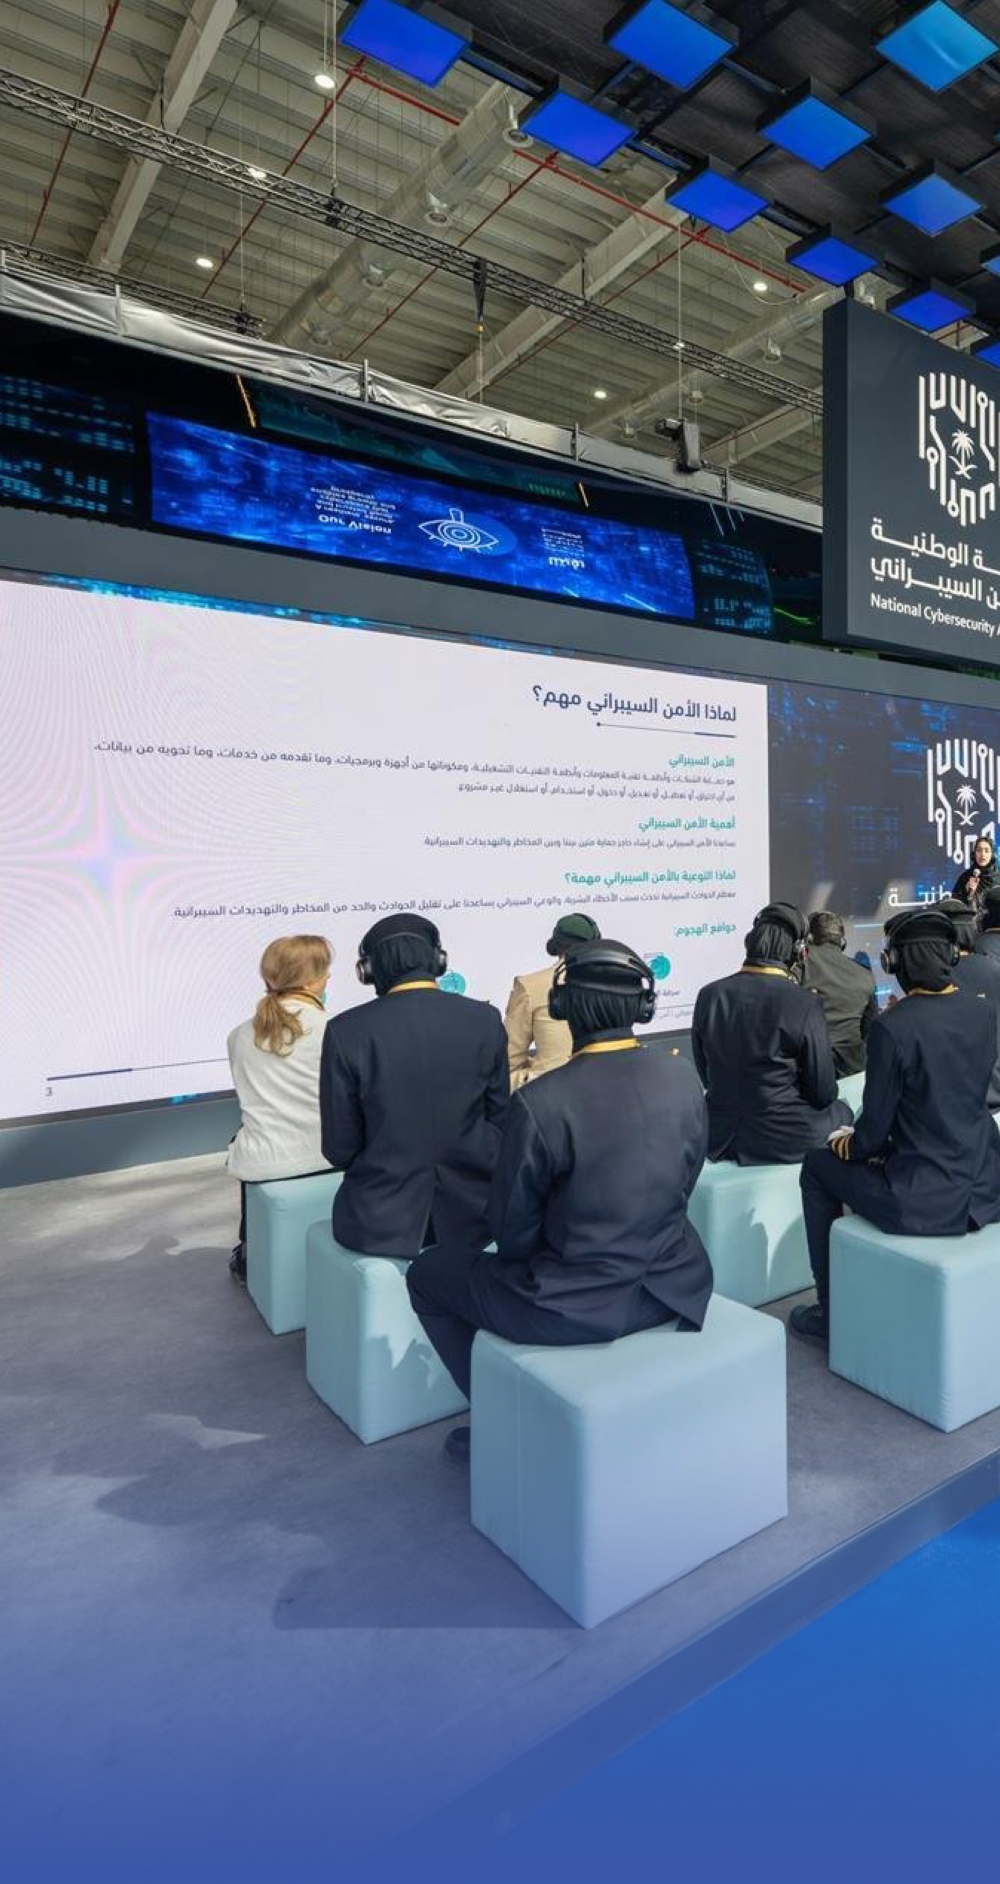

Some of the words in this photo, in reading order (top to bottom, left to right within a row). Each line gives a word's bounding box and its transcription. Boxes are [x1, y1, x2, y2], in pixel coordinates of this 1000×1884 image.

[871, 517, 968, 568] الوطنية
[870, 557, 983, 602] السيبراني
[870, 593, 922, 618] National
[923, 605, 995, 638] Cybersecurity
[532, 685, 582, 708] مهم؟
[587, 693, 658, 716] السيبراني
[663, 701, 701, 720] الأمن
[705, 704, 737, 721] لماذا
